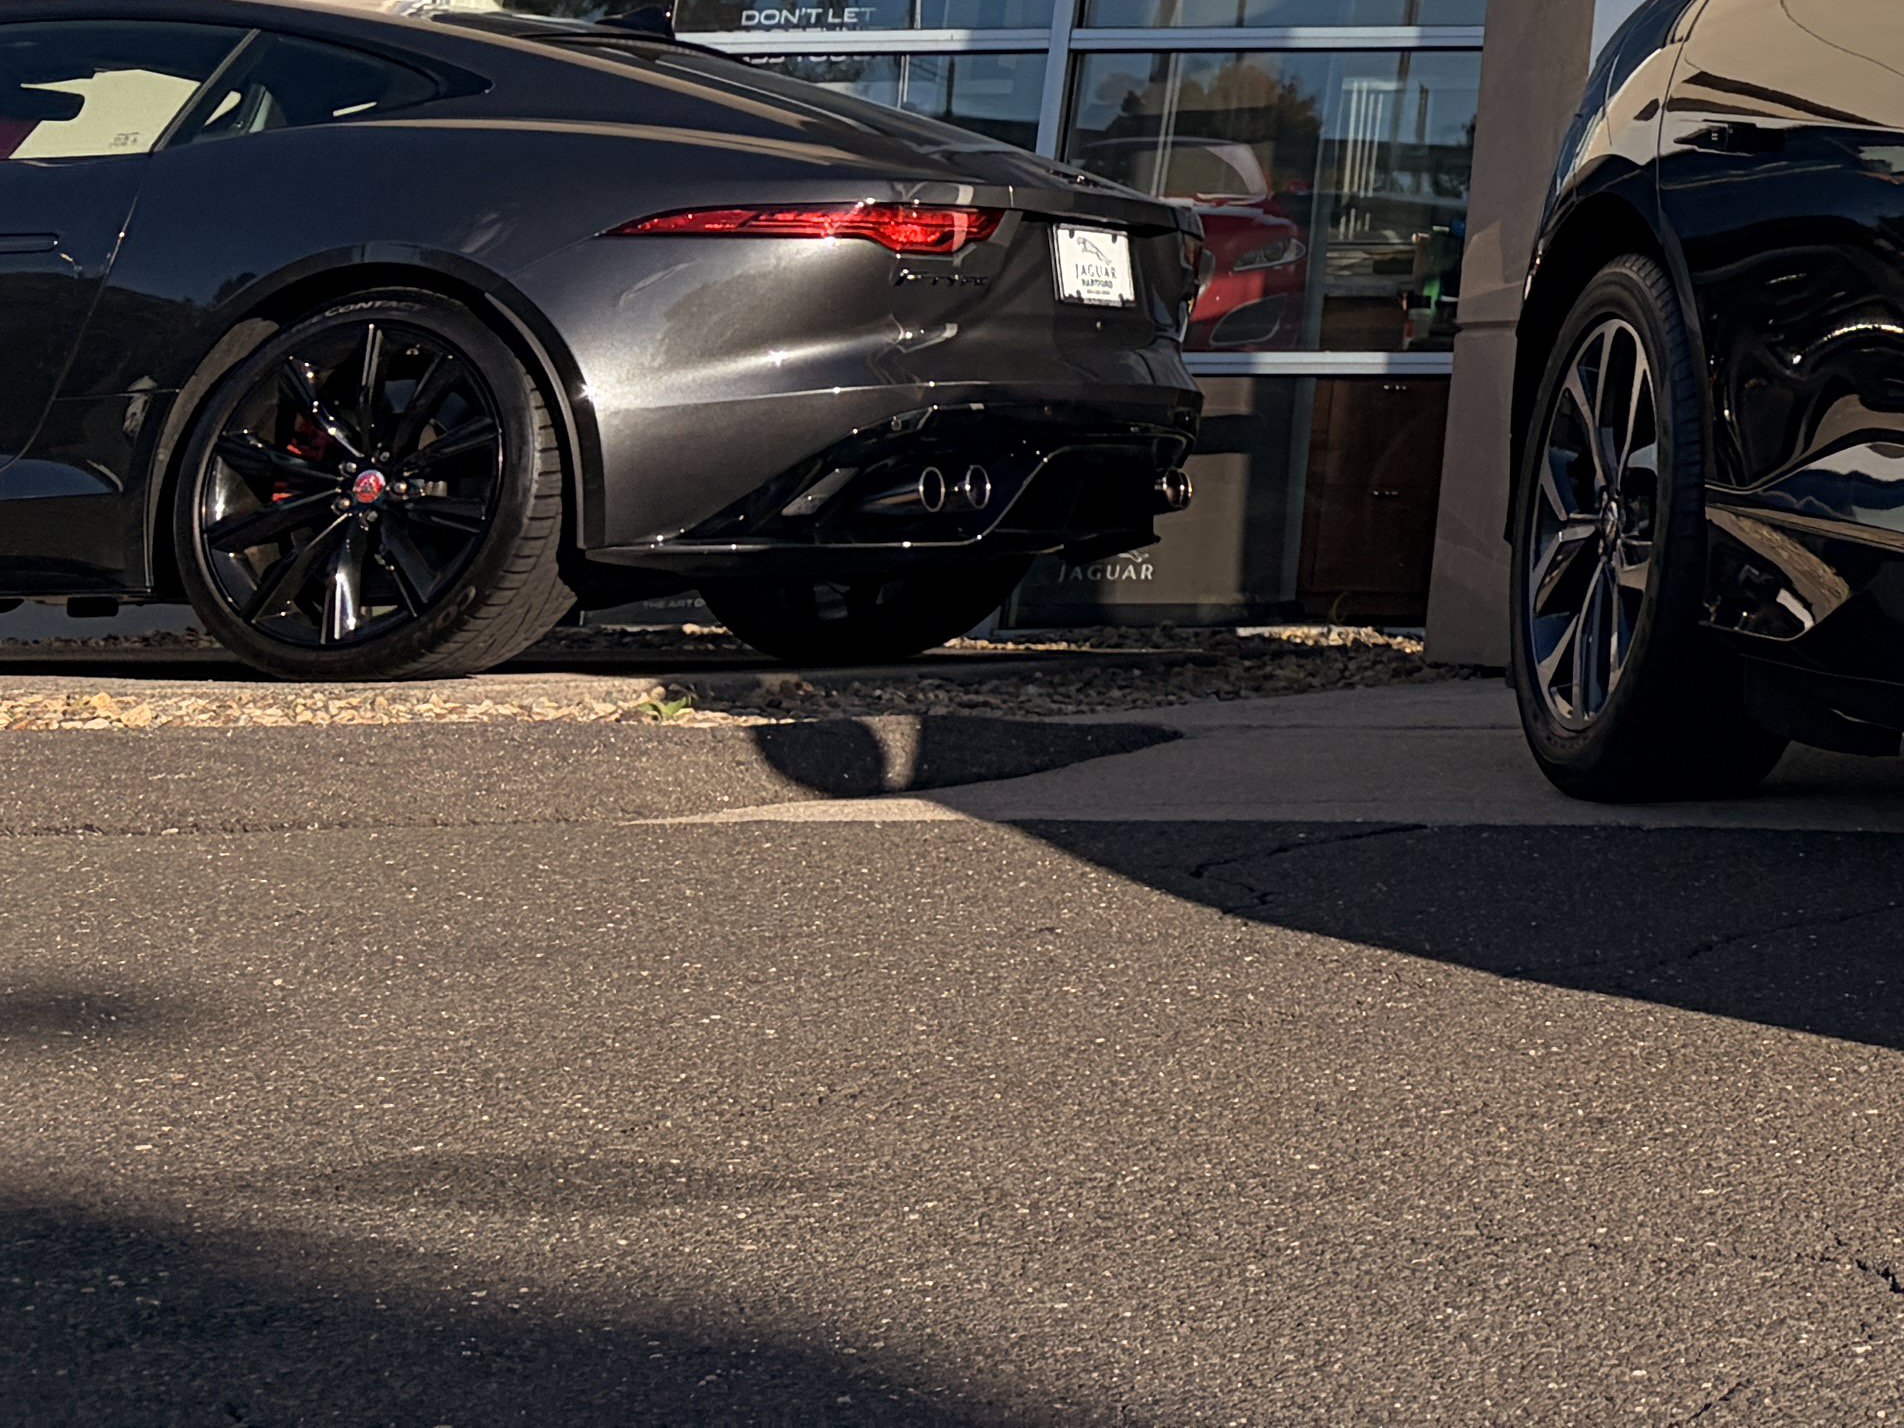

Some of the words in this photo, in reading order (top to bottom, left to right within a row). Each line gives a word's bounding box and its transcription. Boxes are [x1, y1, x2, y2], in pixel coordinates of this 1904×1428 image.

[741, 8, 824, 26] DON'T
[827, 7, 878, 24] LET
[1074, 263, 1117, 279] JAGUAR
[1058, 563, 1154, 585] JAGUAR
